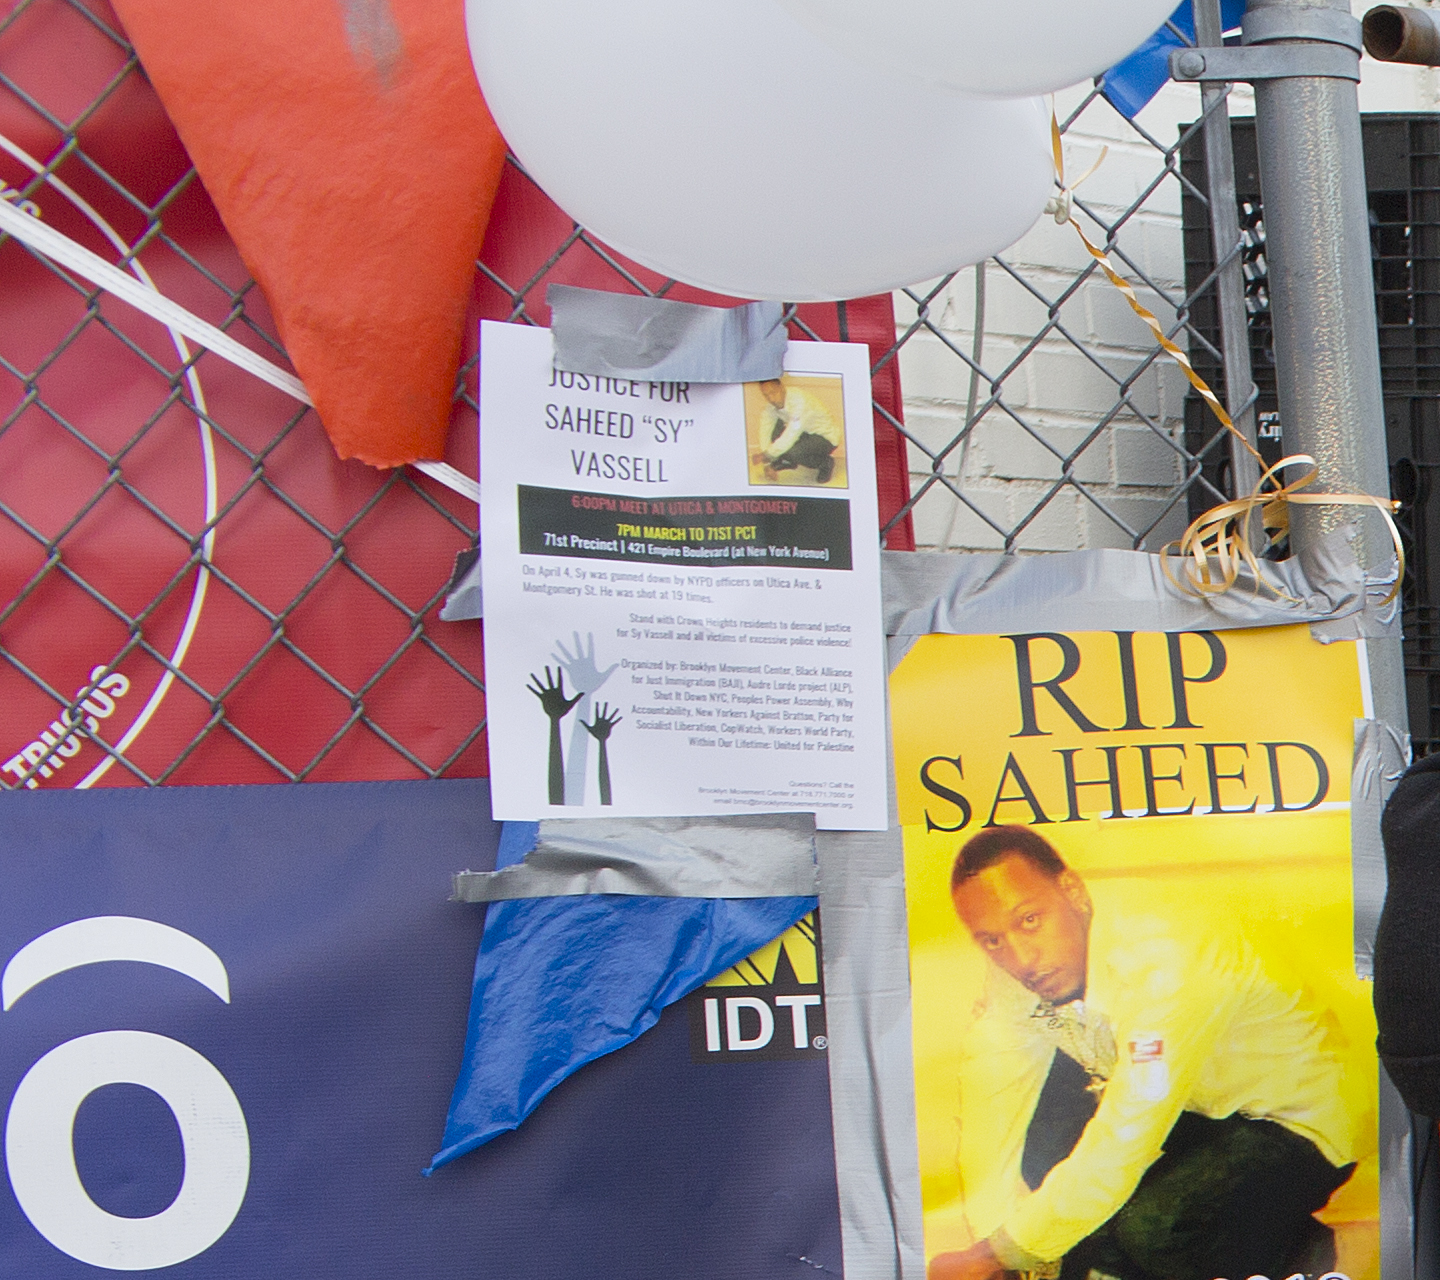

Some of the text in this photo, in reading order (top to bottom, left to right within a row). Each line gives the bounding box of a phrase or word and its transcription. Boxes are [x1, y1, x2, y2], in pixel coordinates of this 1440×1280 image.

[548, 367, 690, 404] JUSTICE FOR
[545, 403, 634, 439] SAHEED
[571, 449, 669, 483] VASSELL
[571, 495, 798, 516] 6:00PM MEET AT UTICA & MONTGOMERY
[544, 532, 567, 549] 71st
[570, 534, 618, 553] Precinct
[627, 542, 645, 554] 421
[648, 544, 680, 558] Empire
[683, 546, 729, 558] Boulevard
[747, 547, 766, 558] New
[769, 547, 790, 559] York
[793, 548, 830, 561] Avenue)
[616, 523, 757, 541] 7PM MARCH TO 71ST PCT
[522, 581, 582, 597] Montgomery
[599, 585, 613, 596] He
[615, 589, 634, 598] was
[636, 588, 656, 599] shot
[659, 589, 668, 599] at
[671, 590, 683, 601] 19
[685, 591, 712, 603] times.
[537, 565, 561, 579] April
[574, 567, 587, 580] Sy
[589, 570, 608, 580] was
[609, 571, 644, 583] gunned
[646, 573, 671, 583] down
[673, 574, 684, 586] by
[715, 576, 750, 588] officers
[752, 578, 764, 587] on
[765, 576, 791, 588] Utica
[792, 577, 812, 589] Ave.
[814, 578, 822, 590] &
[1000, 630, 1227, 738] RIP
[919, 742, 1330, 834] SAHEED
